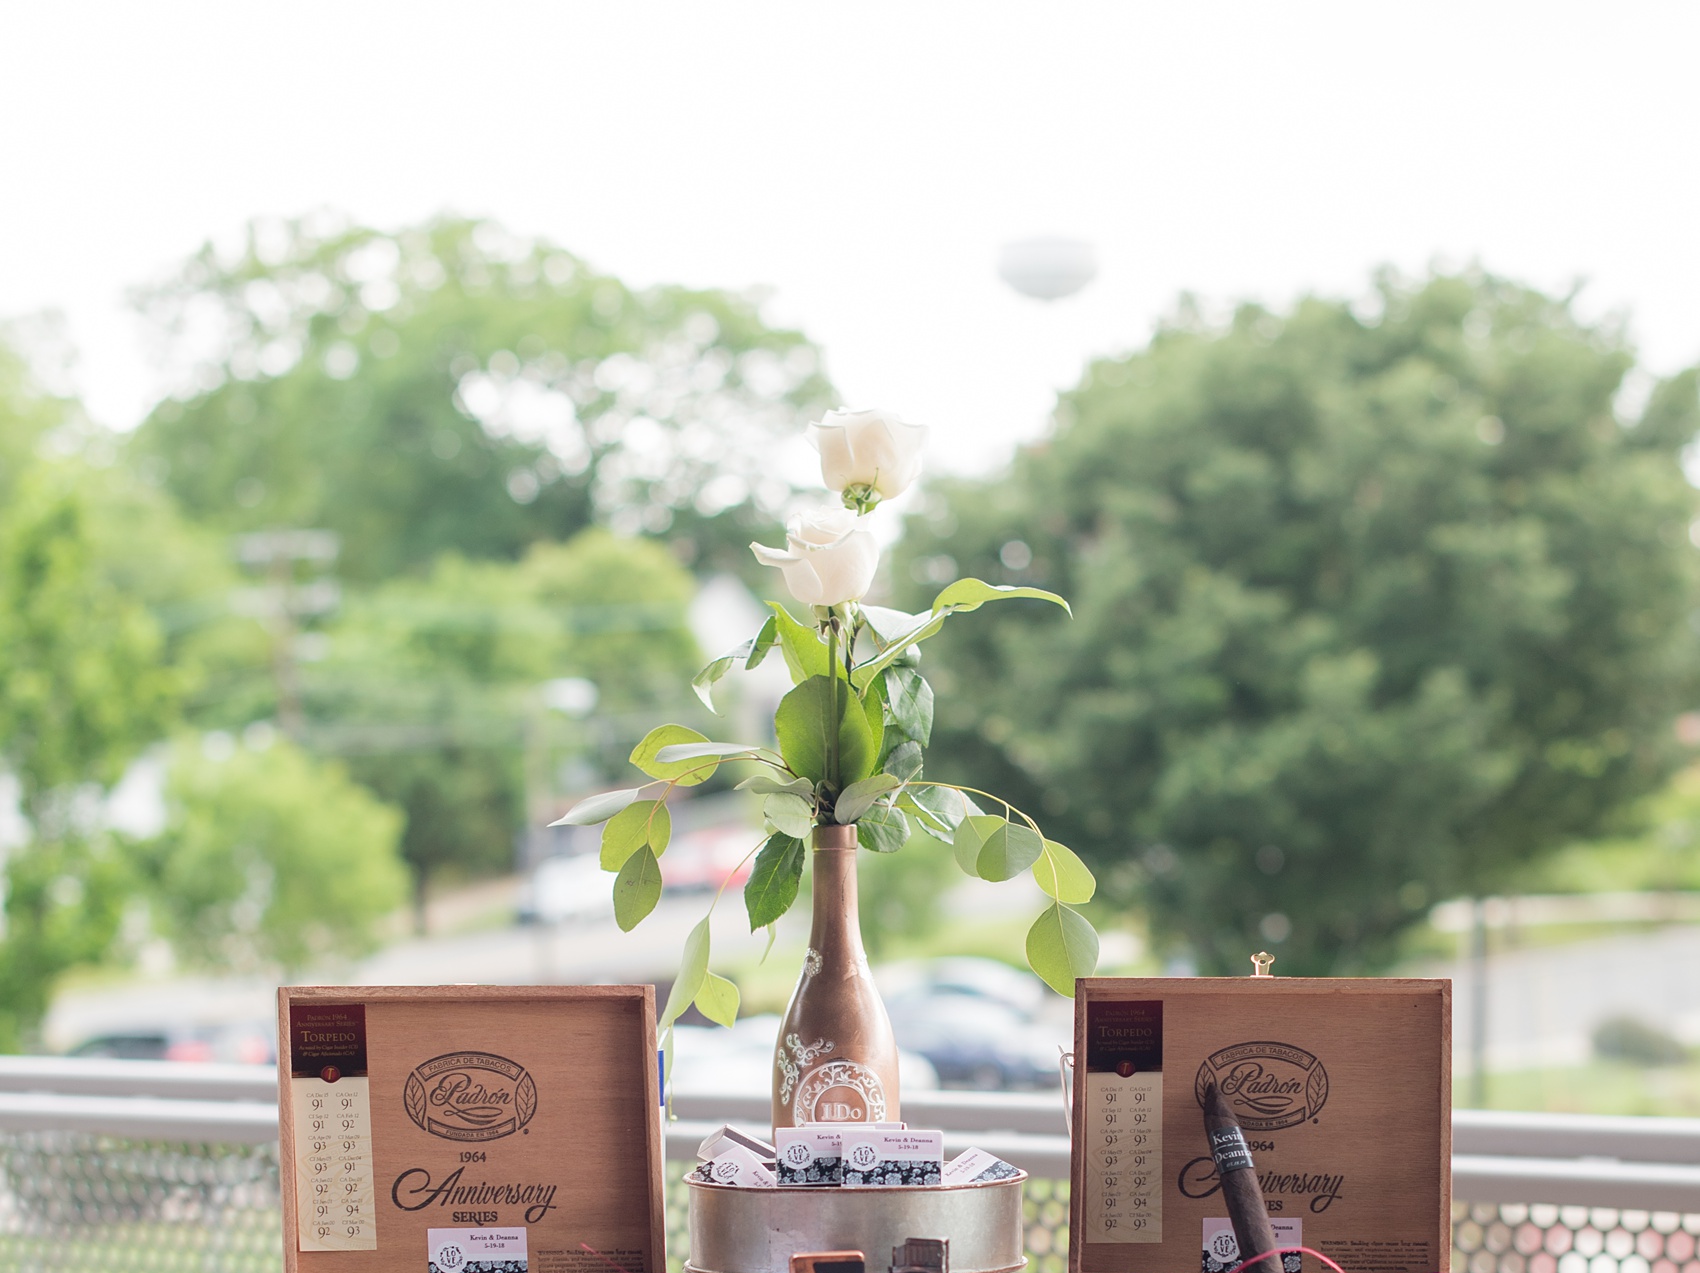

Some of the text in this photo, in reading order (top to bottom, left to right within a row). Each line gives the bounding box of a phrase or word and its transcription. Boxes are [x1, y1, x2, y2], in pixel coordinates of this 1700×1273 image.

[300, 1030, 355, 1042] TORPEDO
[1098, 1026, 1152, 1037] TORPEDO
[1221, 1048, 1254, 1062] FABRICA
[1268, 1047, 1304, 1062] TABACOS
[428, 1058, 462, 1072] FABRICA
[476, 1057, 512, 1072] TABACOS
[1221, 1062, 1304, 1115] Padrón
[341, 1098, 353, 1110] 91
[430, 1072, 513, 1125] Padrón
[1106, 1093, 1117, 1105] 91
[1134, 1093, 1146, 1104] 91
[312, 1099, 323, 1111] 91
[342, 1119, 355, 1131] 92
[1105, 1114, 1117, 1126] 91
[1134, 1114, 1147, 1125] 92
[313, 1120, 324, 1132] 91
[445, 1128, 474, 1138] FUNDADA
[486, 1129, 499, 1137] 1964
[1213, 1131, 1244, 1145] Kevin
[343, 1140, 356, 1153] 93
[1105, 1135, 1118, 1147] 93
[1134, 1135, 1147, 1146] 93
[1248, 1141, 1274, 1152] 1964
[314, 1141, 326, 1153] 93
[459, 1151, 487, 1163] 1964
[1105, 1156, 1118, 1168] 93
[1134, 1156, 1145, 1168] 91
[1215, 1150, 1253, 1164] Deanna
[315, 1162, 327, 1175] 93
[344, 1162, 355, 1174] 91
[345, 1183, 358, 1195] 92
[1105, 1177, 1117, 1189] 92
[1134, 1177, 1146, 1189] 92
[316, 1184, 329, 1196] 92
[391, 1165, 557, 1224] Anniversary
[1105, 1198, 1116, 1210] 91
[1134, 1198, 1146, 1210] 94
[317, 1205, 328, 1217] 91
[346, 1205, 359, 1217] 94
[452, 1211, 498, 1226] SERIES
[1105, 1219, 1117, 1231] 92
[1134, 1219, 1147, 1231] 93
[318, 1227, 330, 1239] 92
[347, 1226, 360, 1238] 93
